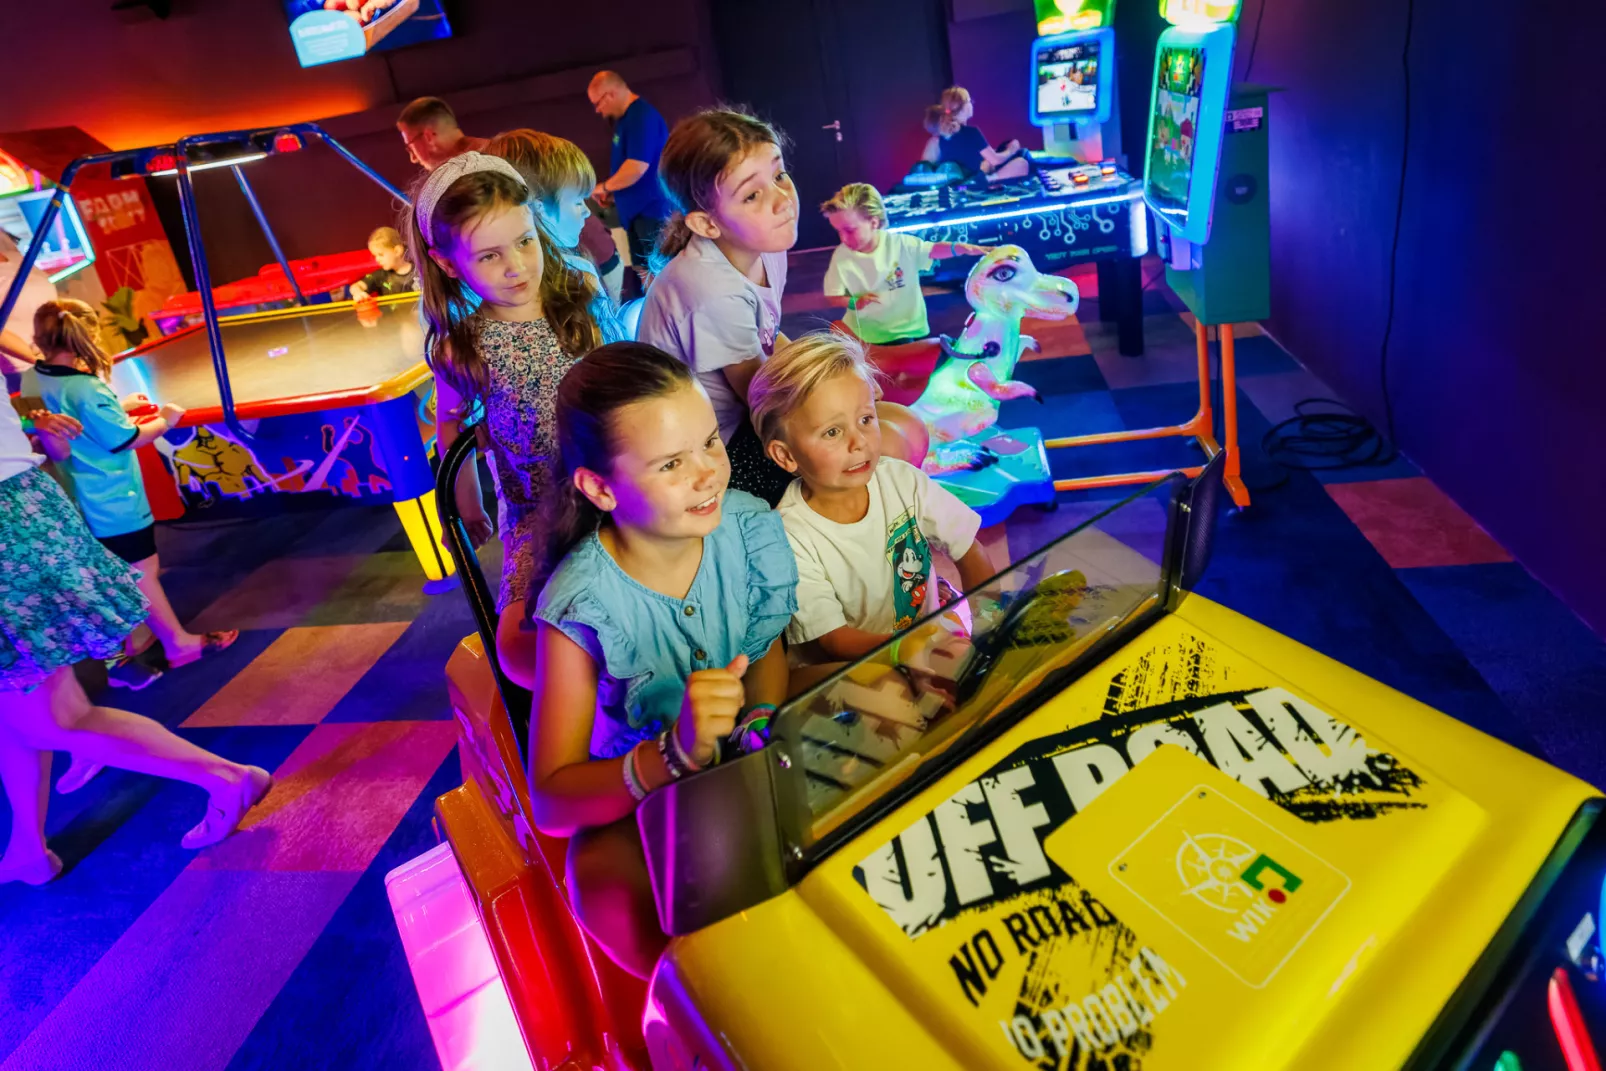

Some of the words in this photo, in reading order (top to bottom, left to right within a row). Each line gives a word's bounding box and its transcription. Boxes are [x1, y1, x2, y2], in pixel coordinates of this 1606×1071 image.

[948, 928, 1005, 1008] NO
[1000, 893, 1118, 956] ROAD
[1226, 897, 1278, 943] WIK
[1041, 946, 1187, 1057] PROBLEM
